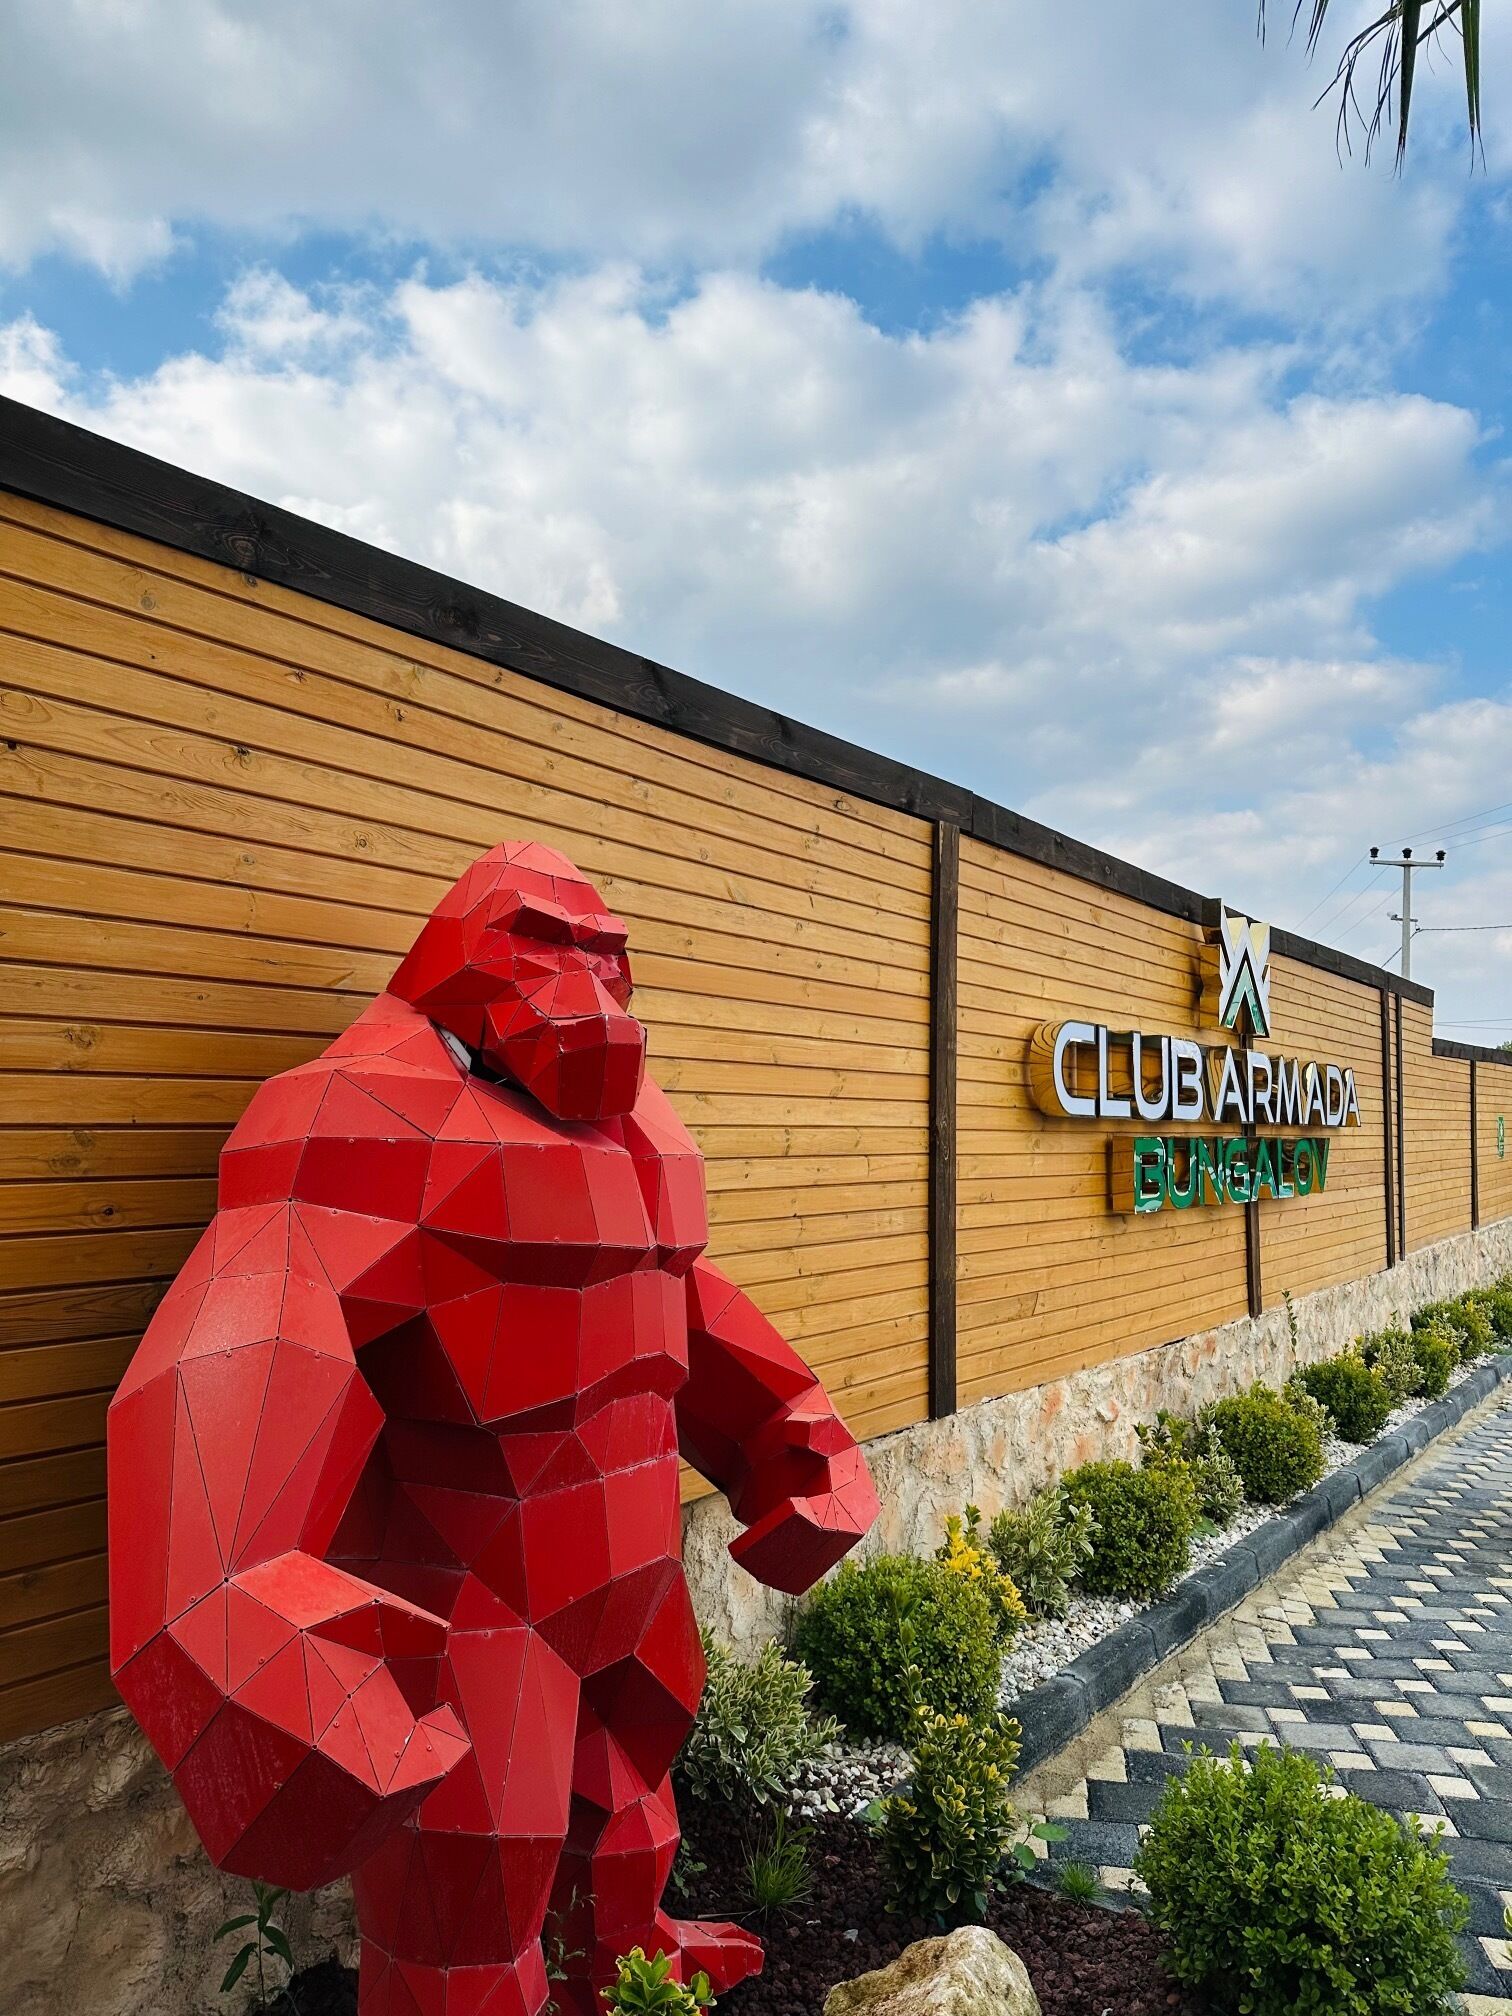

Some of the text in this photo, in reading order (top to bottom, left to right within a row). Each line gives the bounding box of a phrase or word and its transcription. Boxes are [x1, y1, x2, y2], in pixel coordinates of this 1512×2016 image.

[1053, 1020, 1362, 1127] CLUB ARMADA
[1134, 1136, 1331, 1215] BUNGALOV
